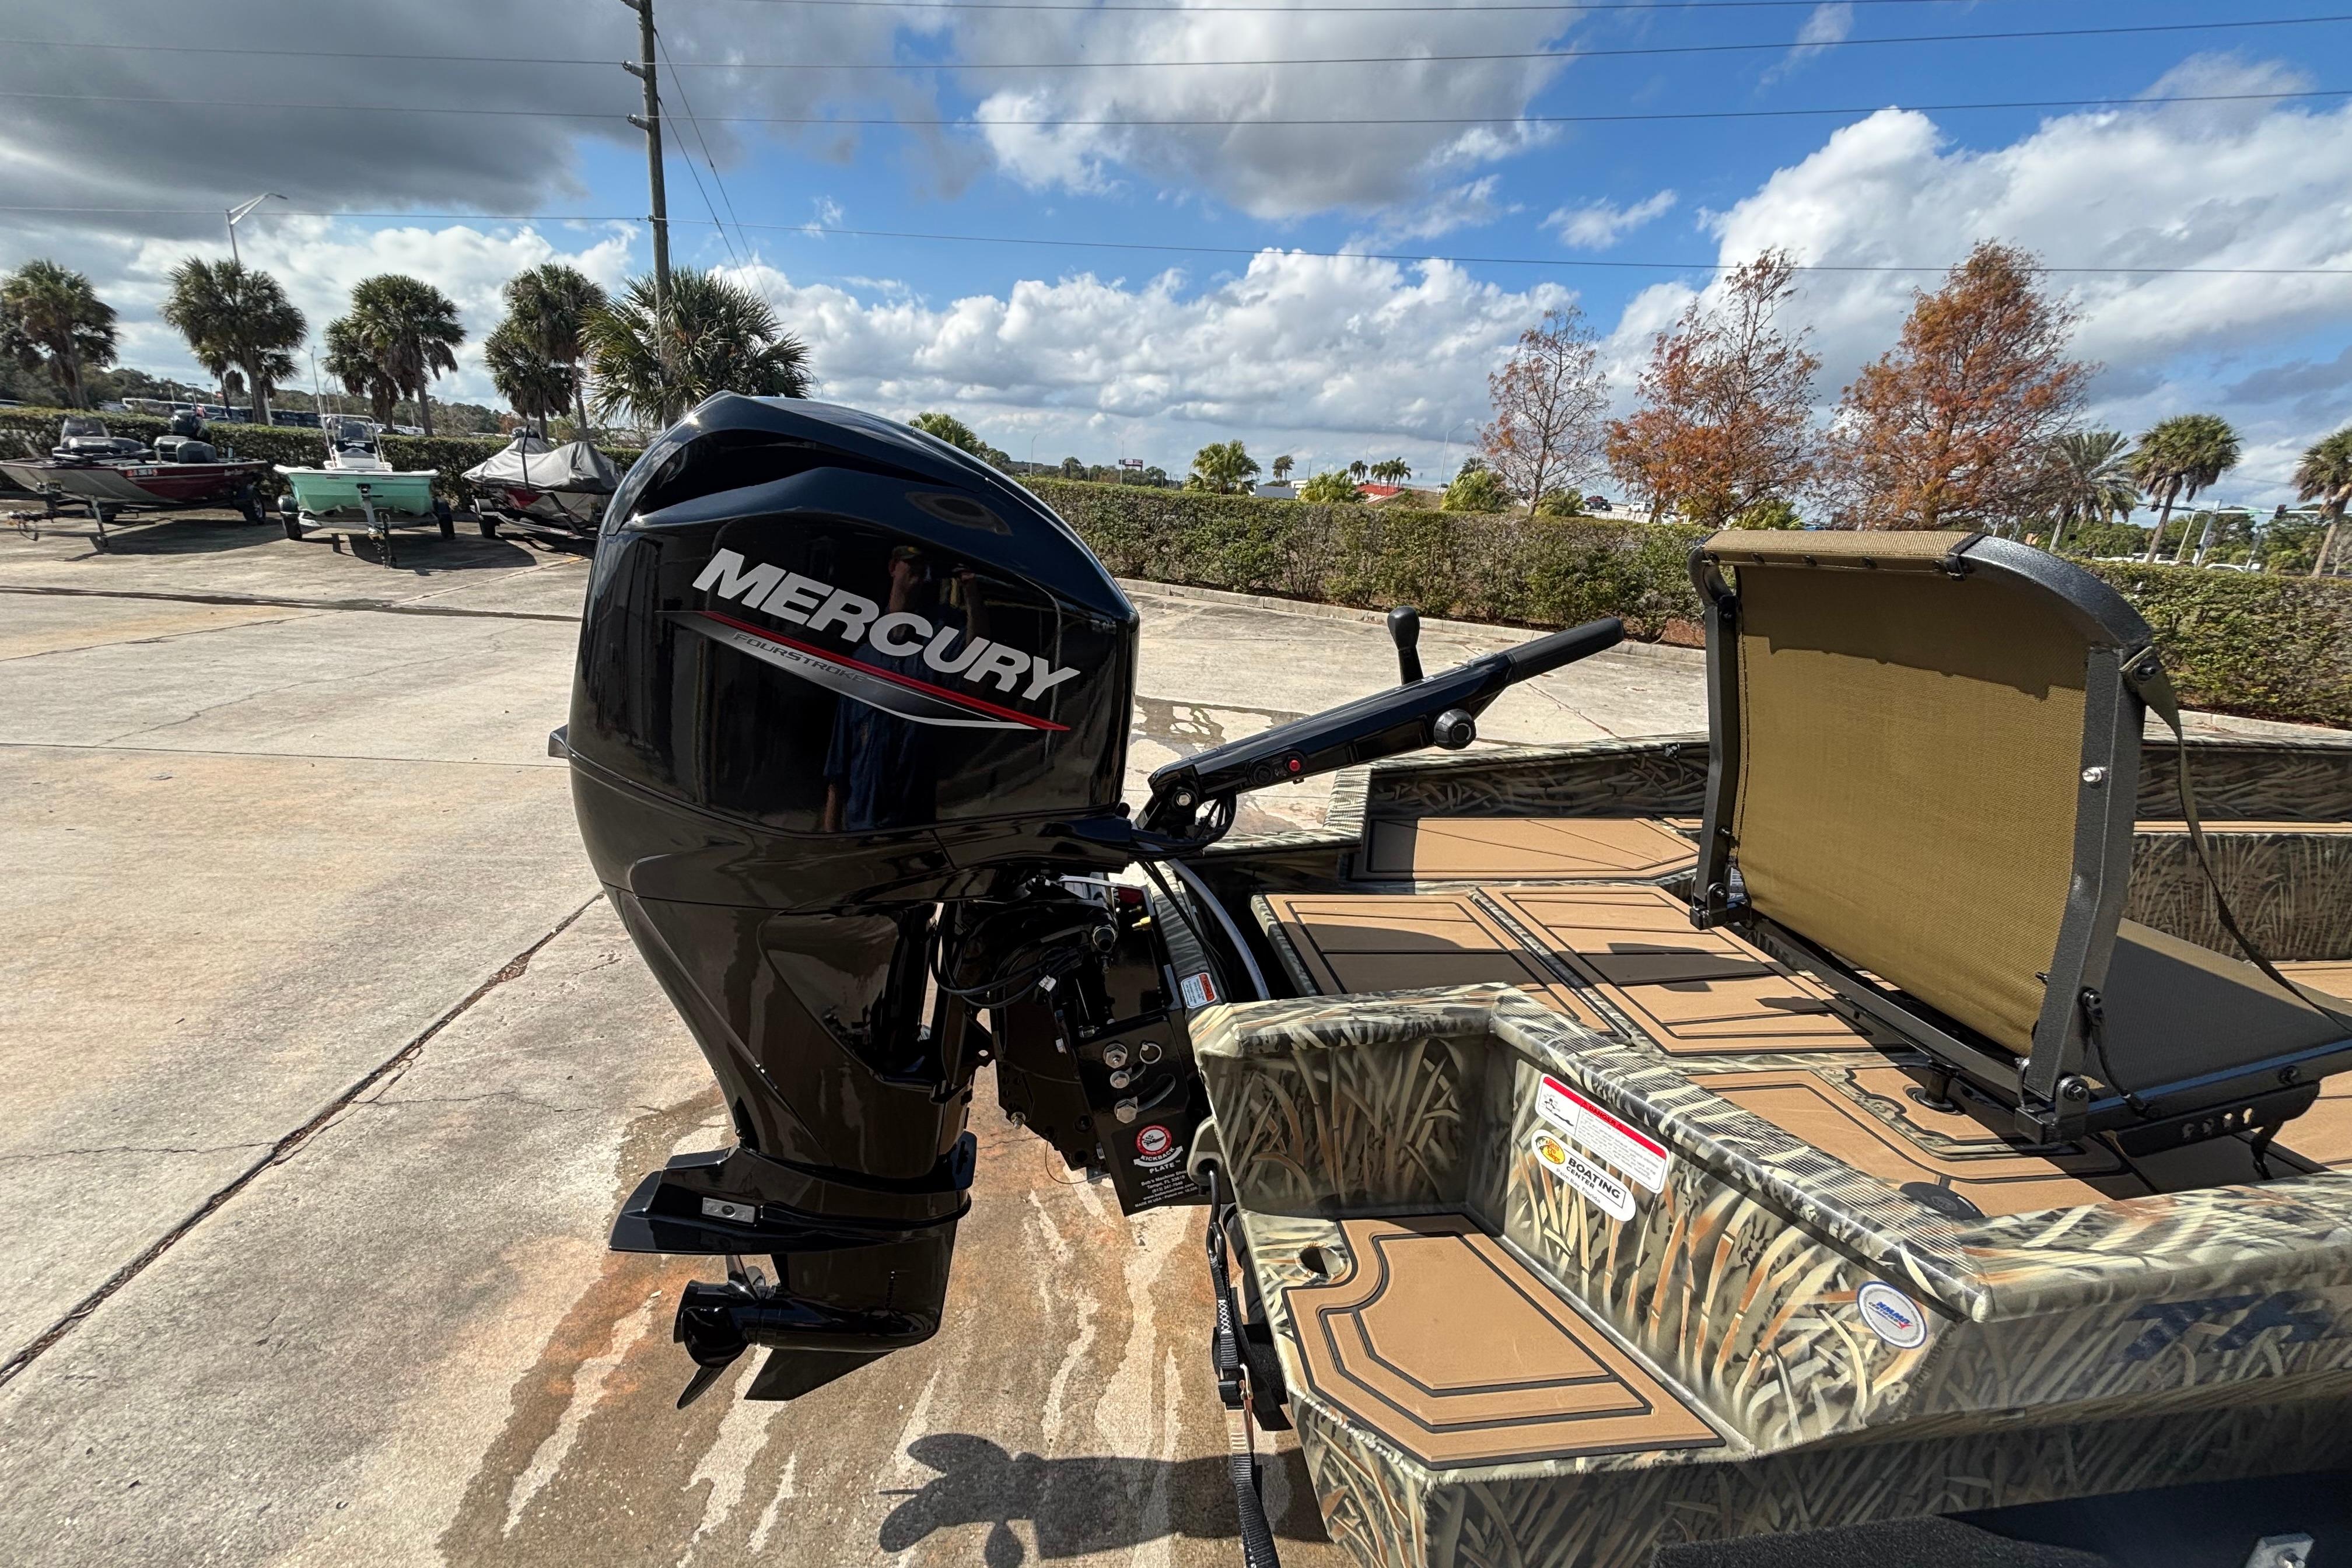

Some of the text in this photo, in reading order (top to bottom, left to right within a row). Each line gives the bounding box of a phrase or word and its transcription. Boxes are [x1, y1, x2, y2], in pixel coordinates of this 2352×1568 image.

[692, 548, 1081, 701] MERCURY
[733, 632, 867, 682] FOURSTROKE
[1588, 1105, 1616, 1126] DANGER
[1140, 1146, 1175, 1161] KICKBACK
[1149, 1162, 1175, 1174] PLATE
[1566, 1166, 1595, 1189] CENTER
[1568, 1157, 1621, 1199] BOATING
[1556, 1167, 1569, 1180] Palm
[1582, 1187, 1601, 1203] Florida
[1868, 1301, 1899, 1322] CERTIFIED
[1876, 1301, 1911, 1324] NMMA
